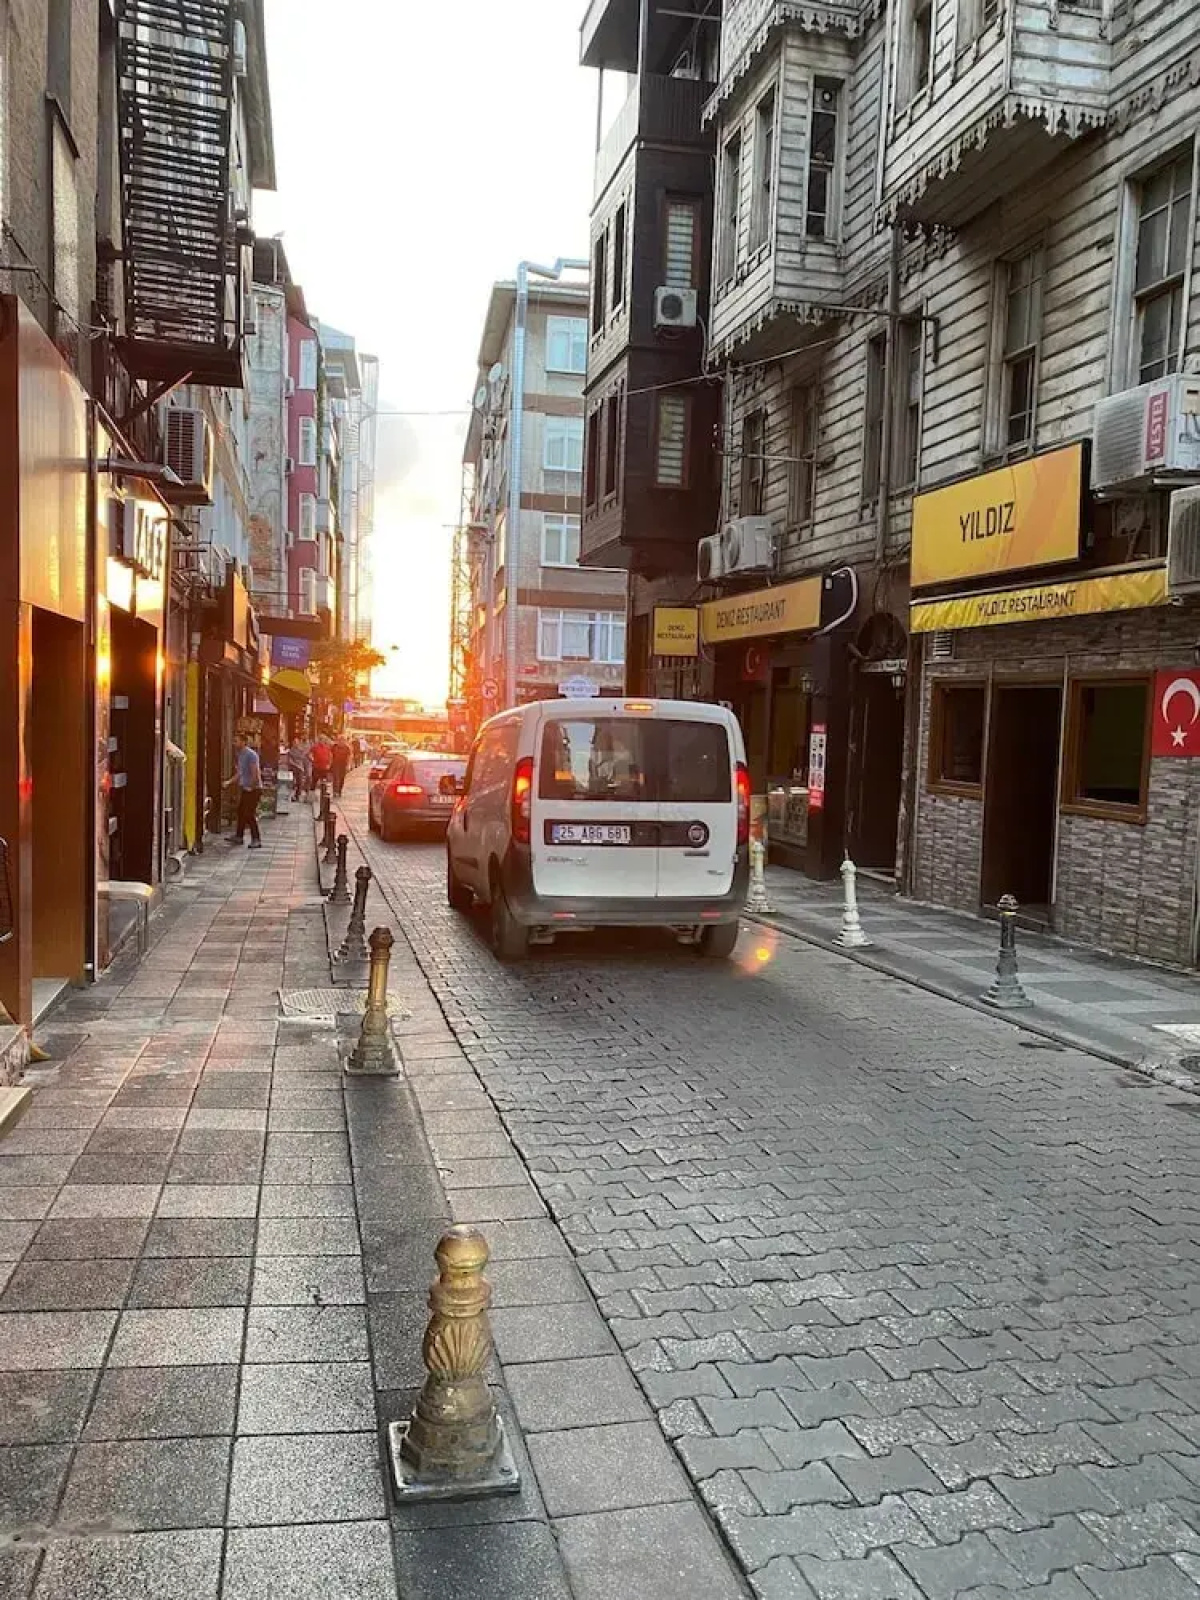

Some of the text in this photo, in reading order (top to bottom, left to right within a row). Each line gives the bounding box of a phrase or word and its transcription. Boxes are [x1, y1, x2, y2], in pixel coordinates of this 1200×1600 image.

[1150, 396, 1164, 455] VESTEL
[959, 501, 1014, 543] YILDIZ
[735, 599, 787, 625] RESTAURANT
[1009, 589, 1077, 616] RESTAURANT
[560, 826, 575, 839] 25
[607, 826, 628, 839] 681
